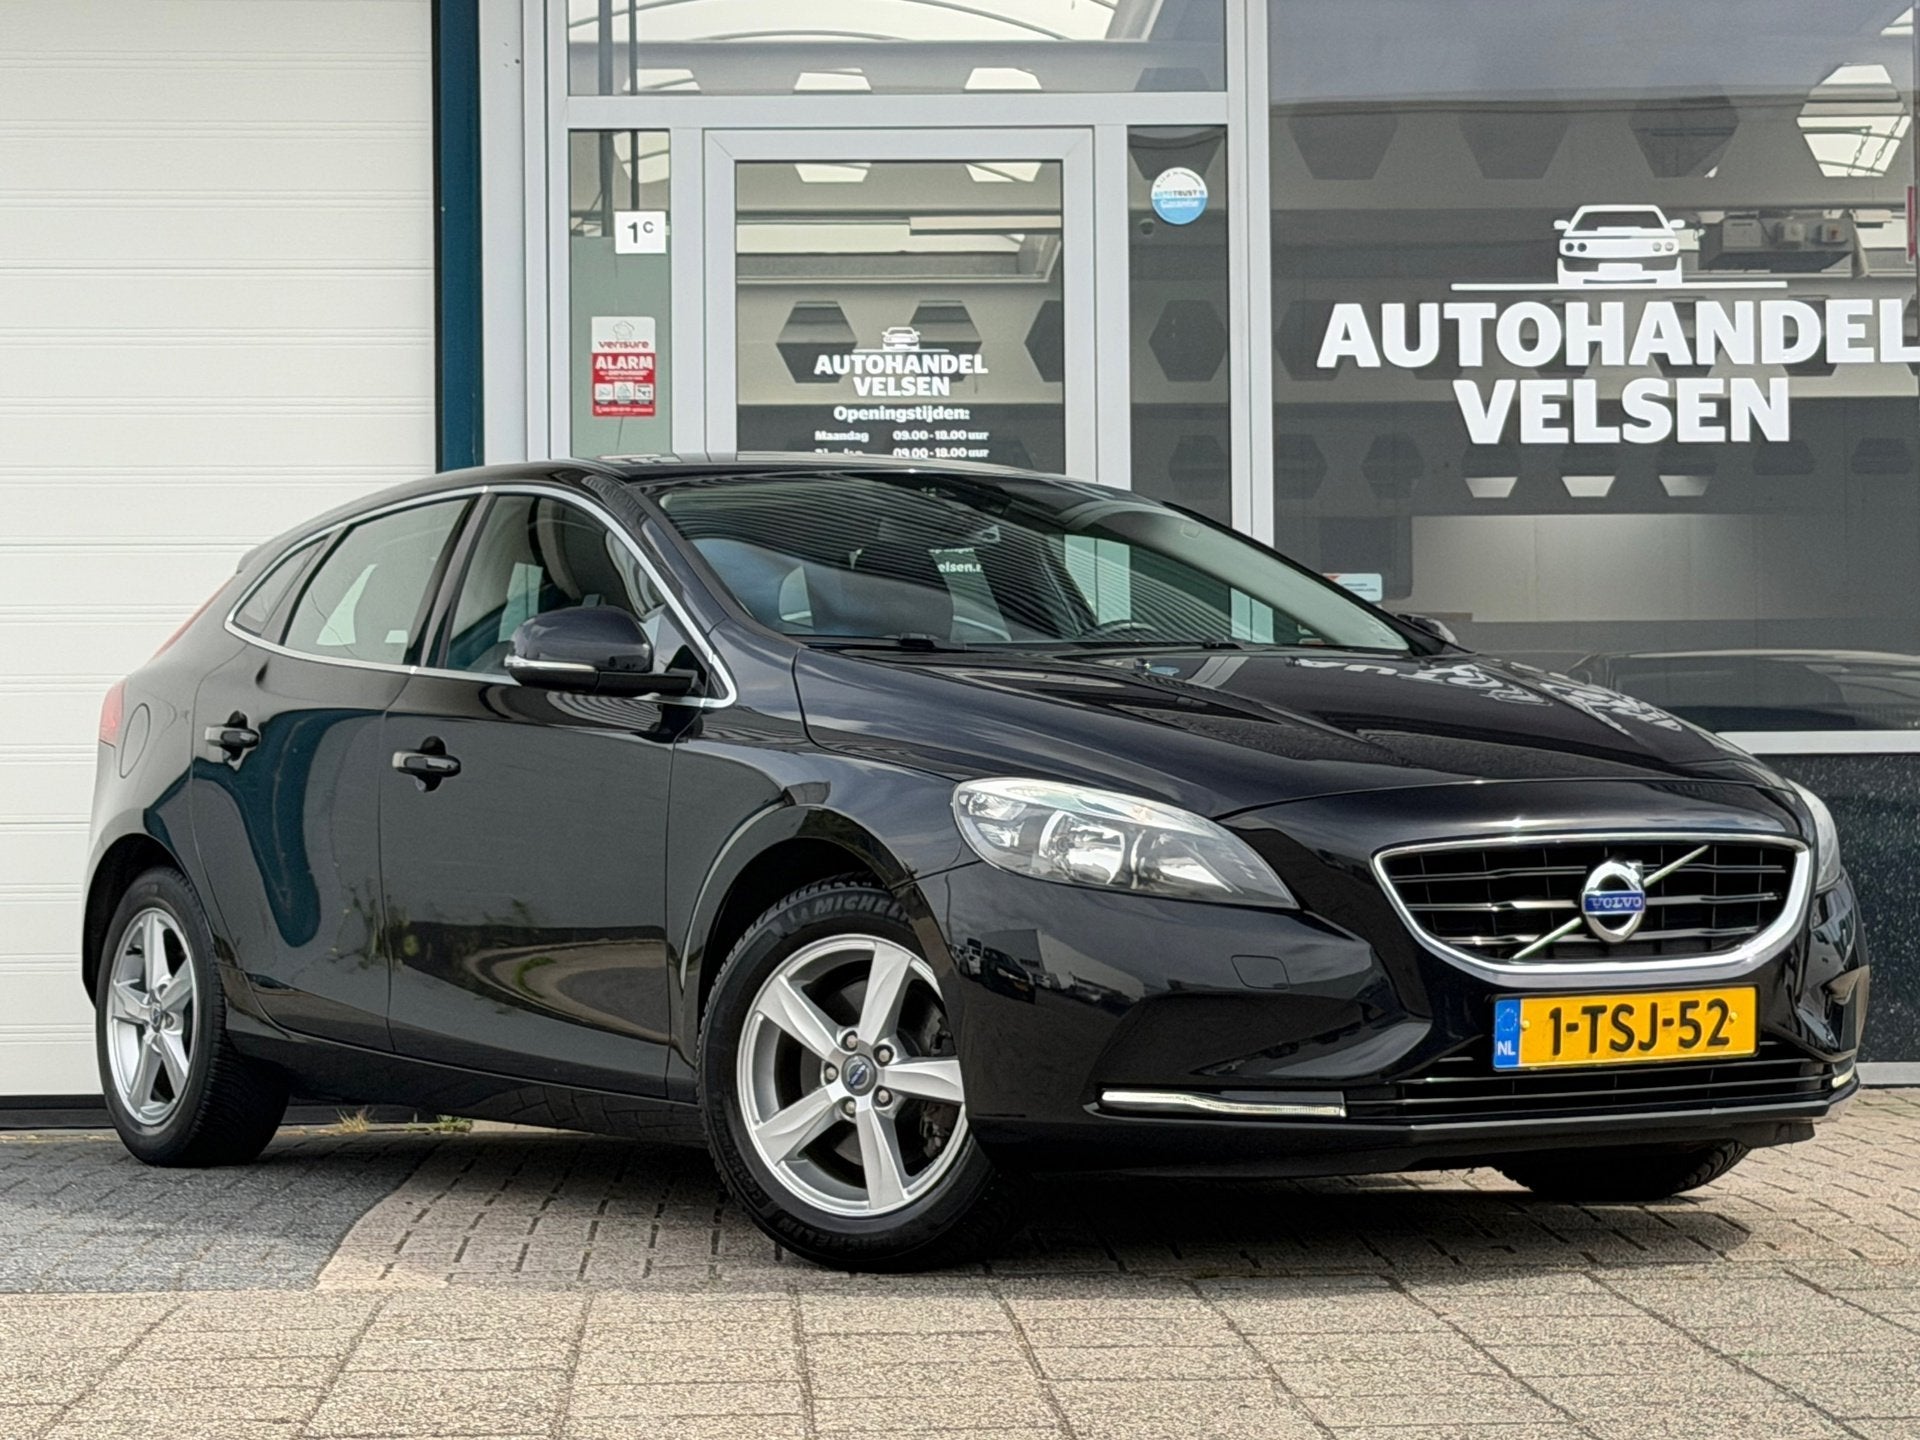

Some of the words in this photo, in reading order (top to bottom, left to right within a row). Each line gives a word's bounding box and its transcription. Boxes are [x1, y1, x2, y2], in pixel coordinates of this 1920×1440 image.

[1316, 299, 1920, 368] AUTOHANDEL
[595, 355, 653, 370] ALARM
[814, 354, 989, 375] AUTOHANDEL
[852, 377, 950, 396] VELSEN
[833, 405, 971, 423] Openingstijden:
[1452, 376, 1790, 444] VELSEN
[814, 430, 869, 443] Maandag
[967, 431, 990, 441] uur
[814, 895, 909, 923] MICHEL
[1588, 896, 1642, 909] VOLVO
[1549, 998, 1730, 1056] 1-TSJ-52
[1497, 1040, 1516, 1056] NL
